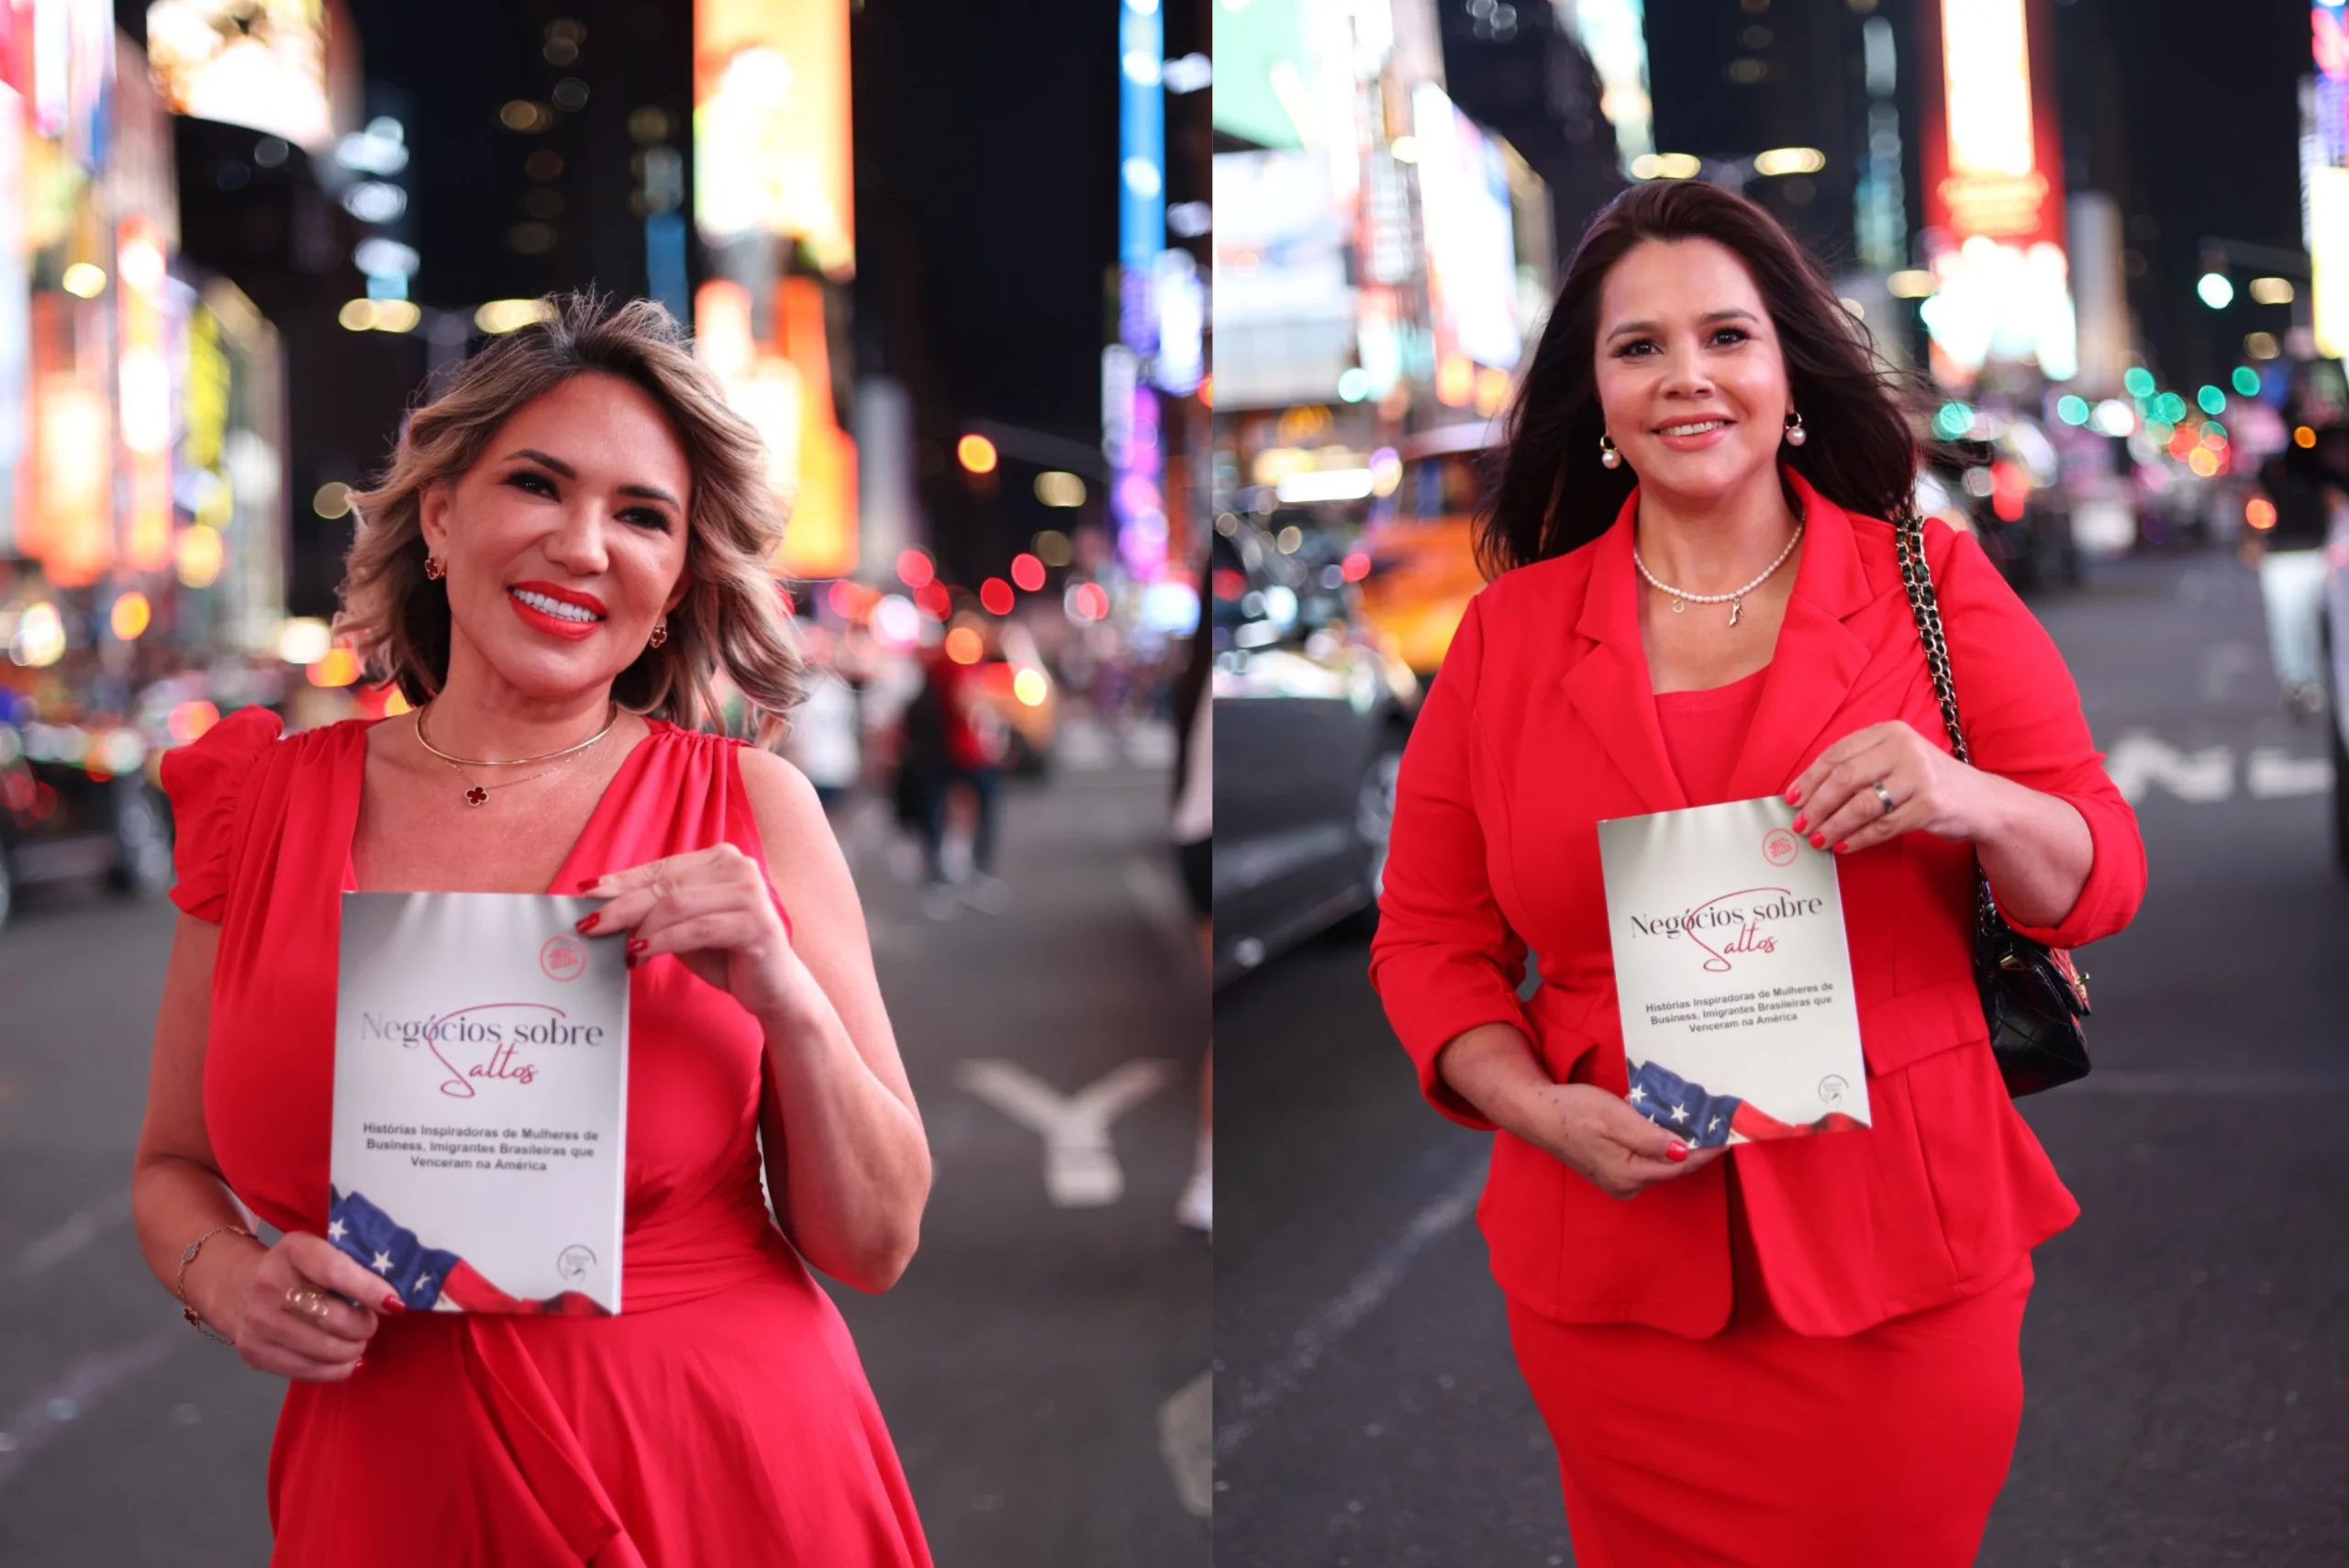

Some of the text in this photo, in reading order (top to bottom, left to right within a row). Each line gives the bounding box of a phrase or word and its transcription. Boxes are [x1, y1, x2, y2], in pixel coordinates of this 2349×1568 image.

[1631, 895, 1822, 940] Negócios sobre
[1687, 886, 1791, 973] Saltos
[1645, 982, 1833, 1013] Histórias Inspiradoras de Mulheres de
[1650, 995, 1832, 1026] Business, Imigrantes Brasileiras que
[362, 1012, 604, 1049] Negócios sobre
[1689, 1013, 1798, 1033] Venceram na América
[428, 1002, 566, 1099] Saltos
[363, 1122, 599, 1141] Histórias Inspiradoras de Mulheres de
[366, 1138, 595, 1160] Business, Imigrantes Brasileiras que
[410, 1155, 548, 1172] Venceram na América
